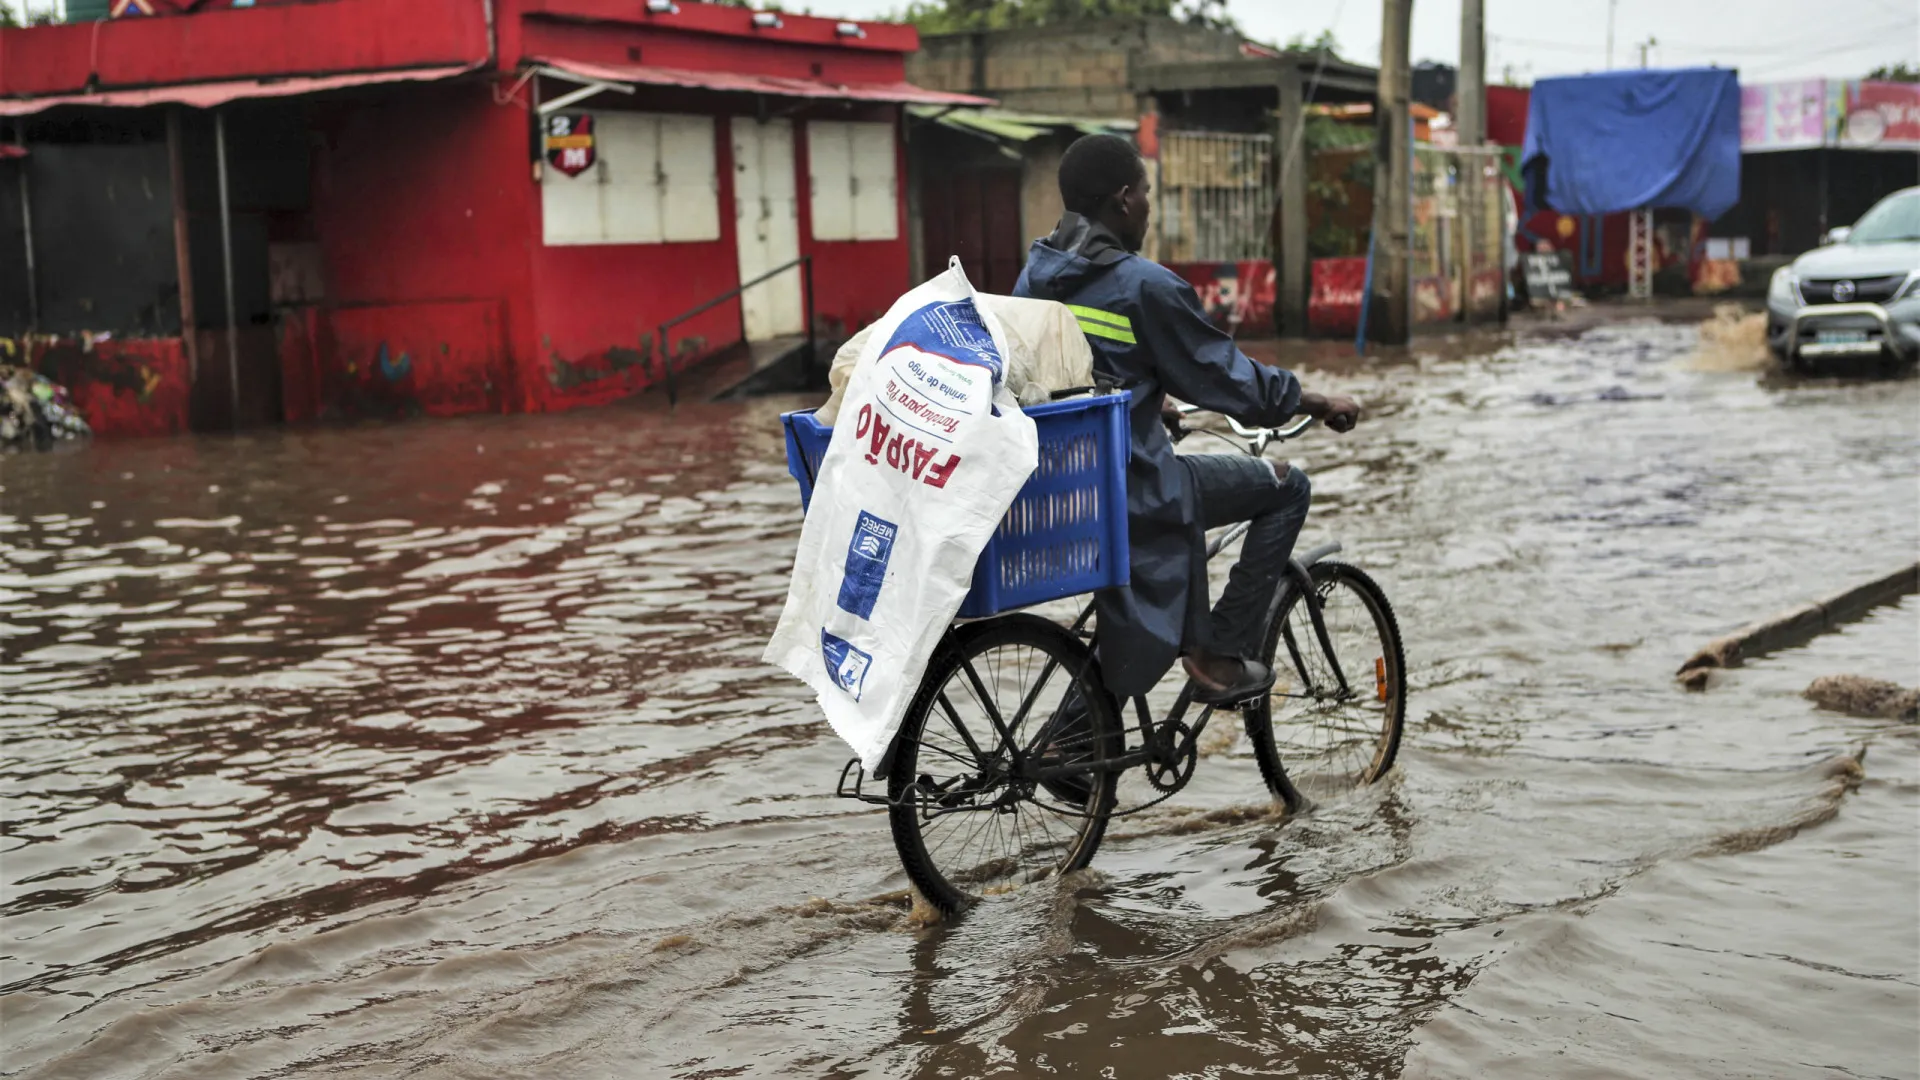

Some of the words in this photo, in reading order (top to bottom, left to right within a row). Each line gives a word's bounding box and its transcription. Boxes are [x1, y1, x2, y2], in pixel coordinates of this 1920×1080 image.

[551, 115, 571, 136] 2
[563, 147, 587, 168] M
[907, 360, 928, 382] Trigo
[926, 375, 939, 388] de
[897, 392, 928, 416] para
[920, 408, 961, 434] Farinha
[855, 402, 962, 489] FASPÃO
[861, 516, 895, 539] MEREC
